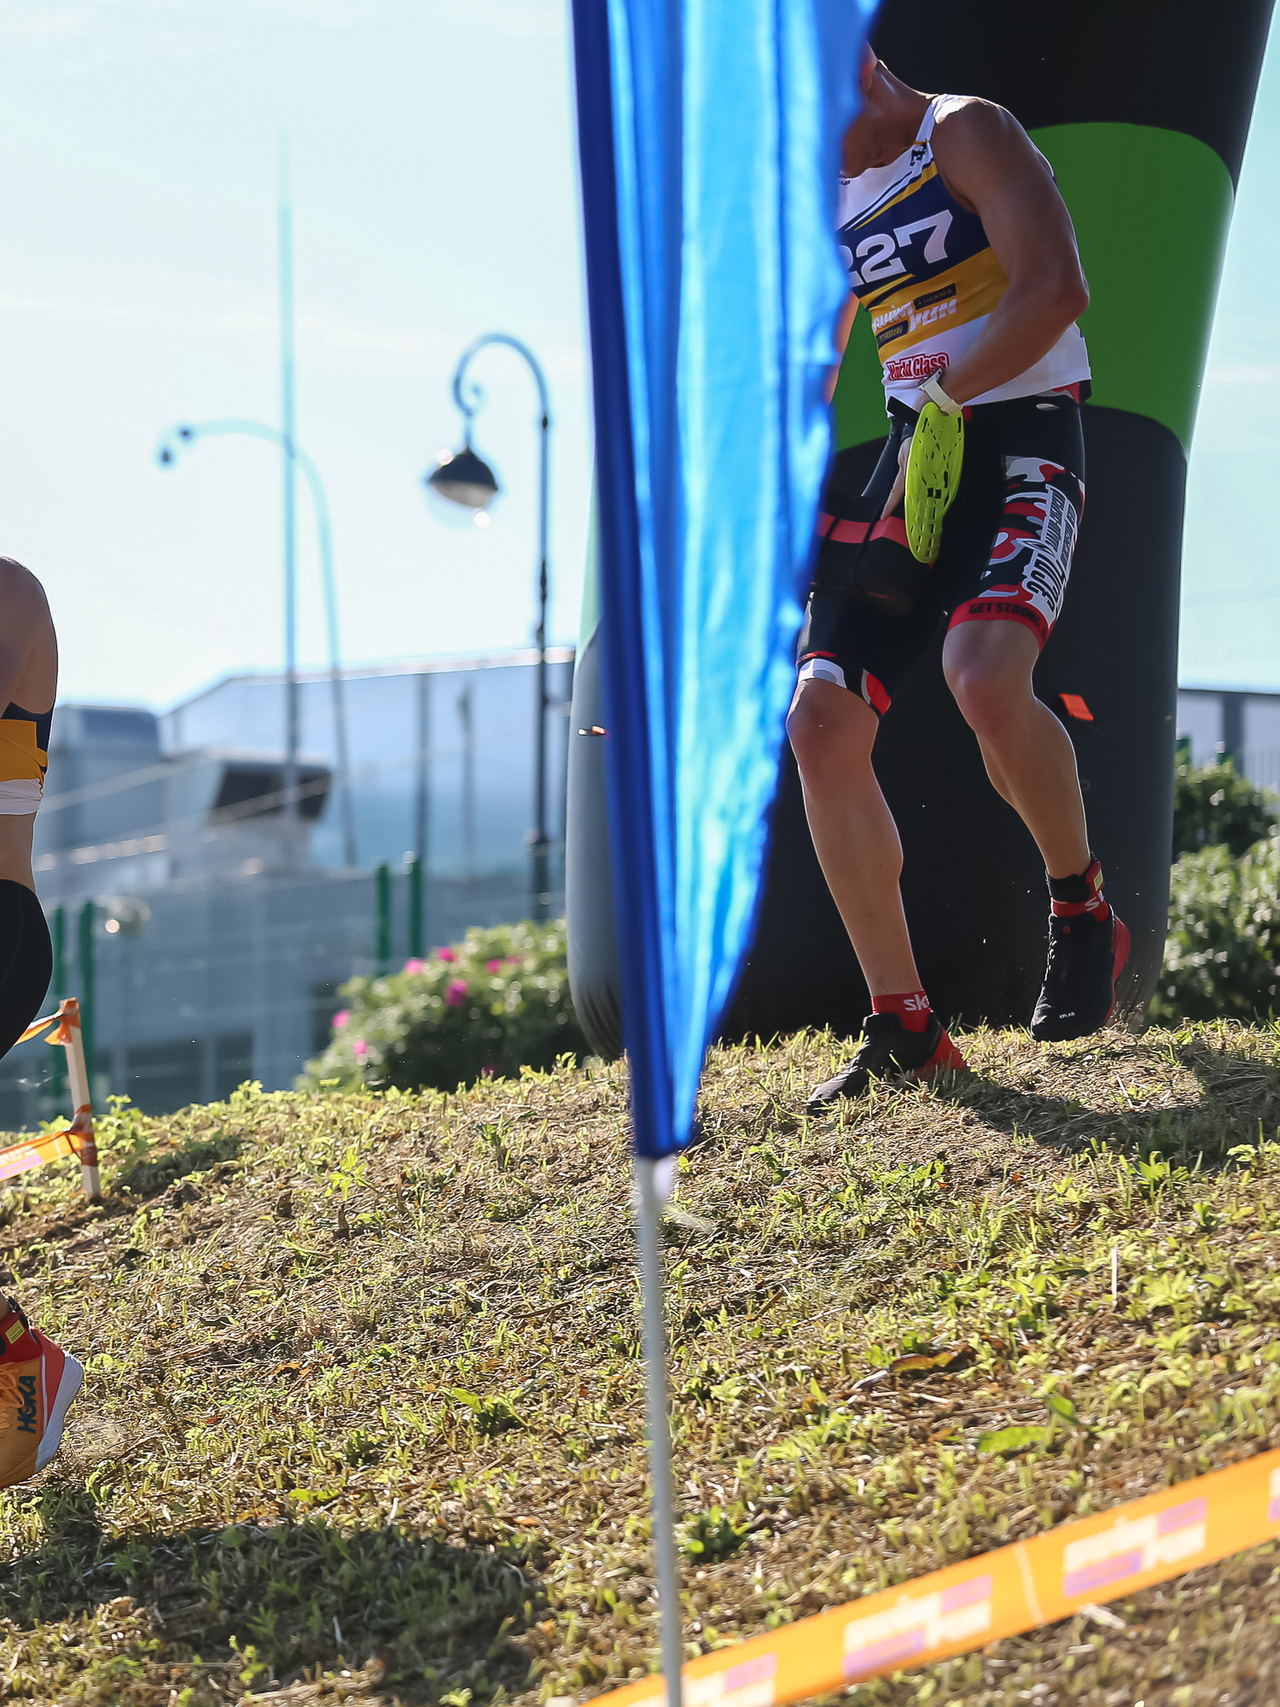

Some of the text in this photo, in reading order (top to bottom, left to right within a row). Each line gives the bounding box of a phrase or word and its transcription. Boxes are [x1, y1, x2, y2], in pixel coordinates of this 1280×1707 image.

[913, 355, 947, 377] Class
[969, 602, 994, 615] GET
[17, 1375, 37, 1434] HOKA
